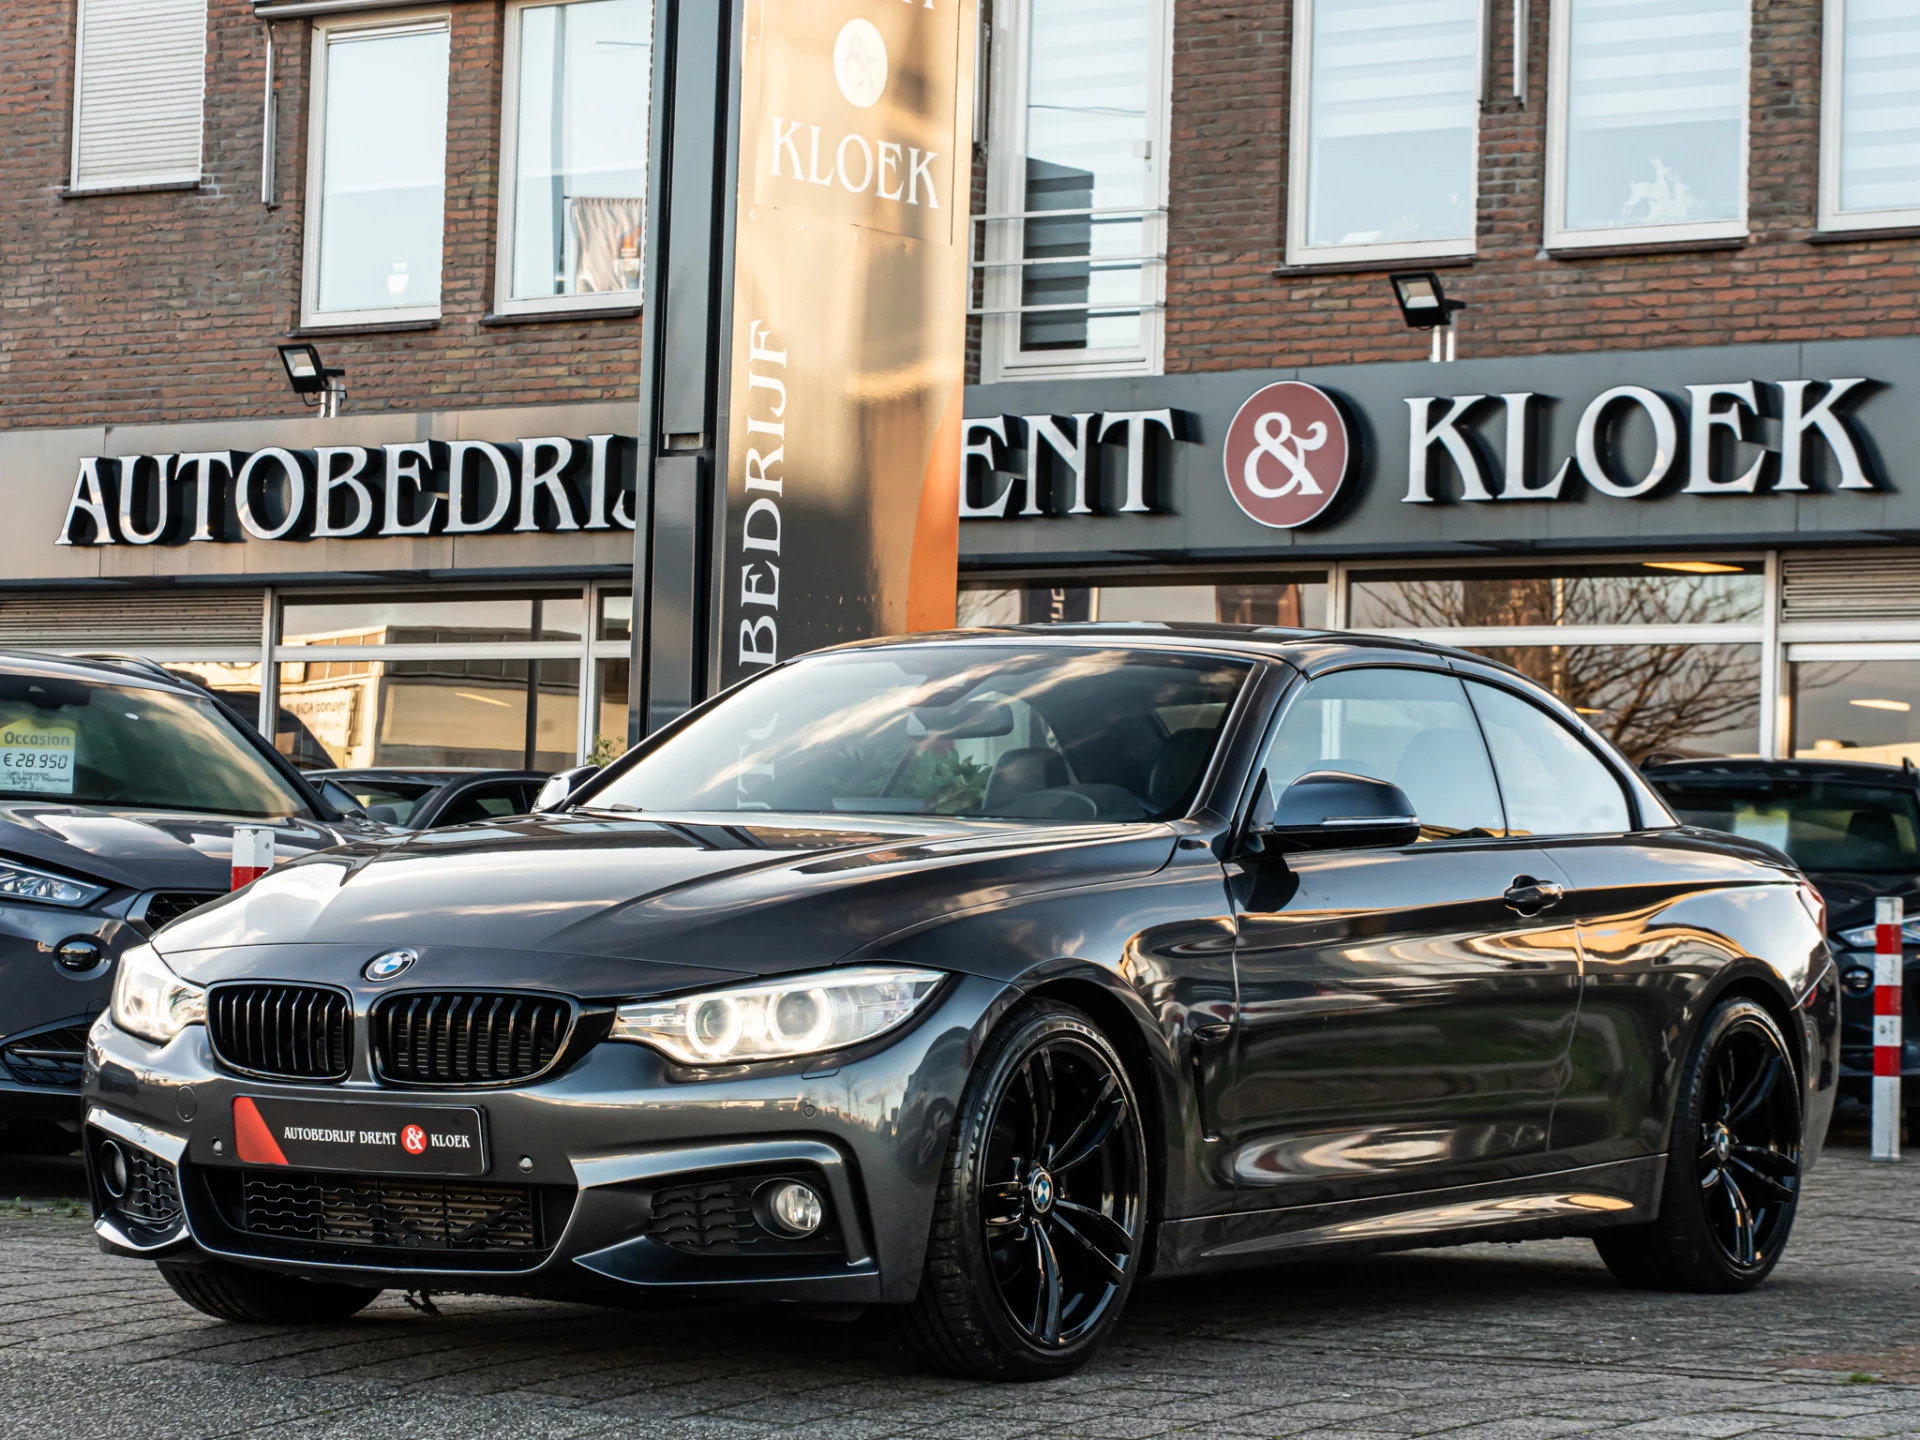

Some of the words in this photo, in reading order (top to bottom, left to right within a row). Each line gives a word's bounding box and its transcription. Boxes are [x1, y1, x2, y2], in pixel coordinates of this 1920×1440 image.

[769, 116, 940, 209] KLOEK
[1243, 411, 1328, 499] &
[1401, 377, 1874, 503] KLOEK
[4, 731, 70, 746] Occasion
[16, 753, 68, 769] 28.950
[284, 1126, 356, 1144] AUTOBEDRIJF
[360, 1131, 397, 1146] DRENT
[406, 1128, 423, 1150] &
[431, 1134, 470, 1148] KLOEK
